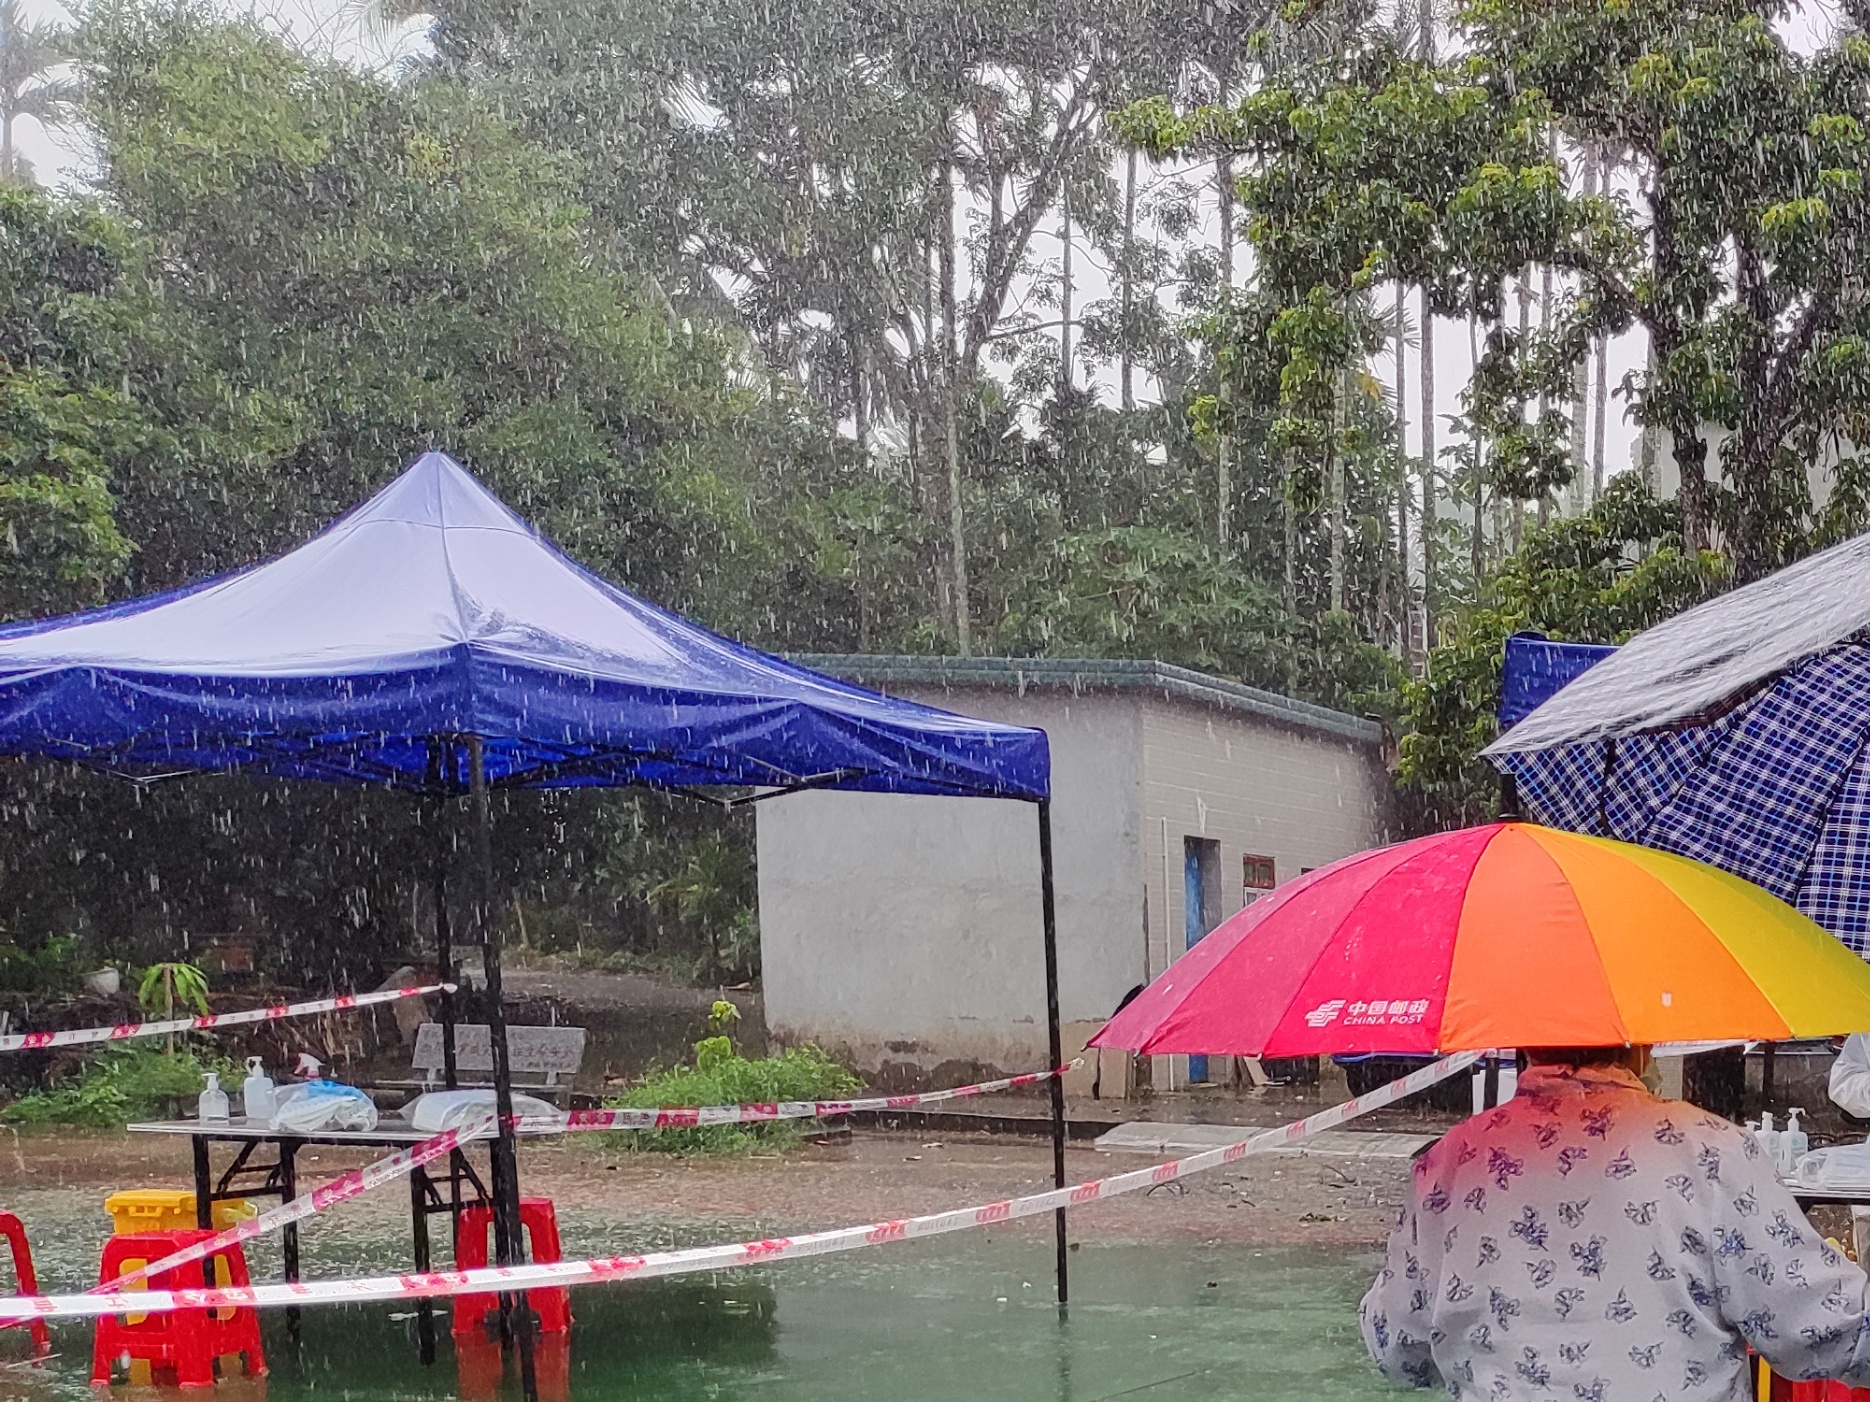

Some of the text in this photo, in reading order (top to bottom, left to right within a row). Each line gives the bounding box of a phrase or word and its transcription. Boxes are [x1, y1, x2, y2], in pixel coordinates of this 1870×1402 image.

[1347, 999, 1430, 1016] 中国邮政
[1343, 1014, 1424, 1025] CHINA POST
